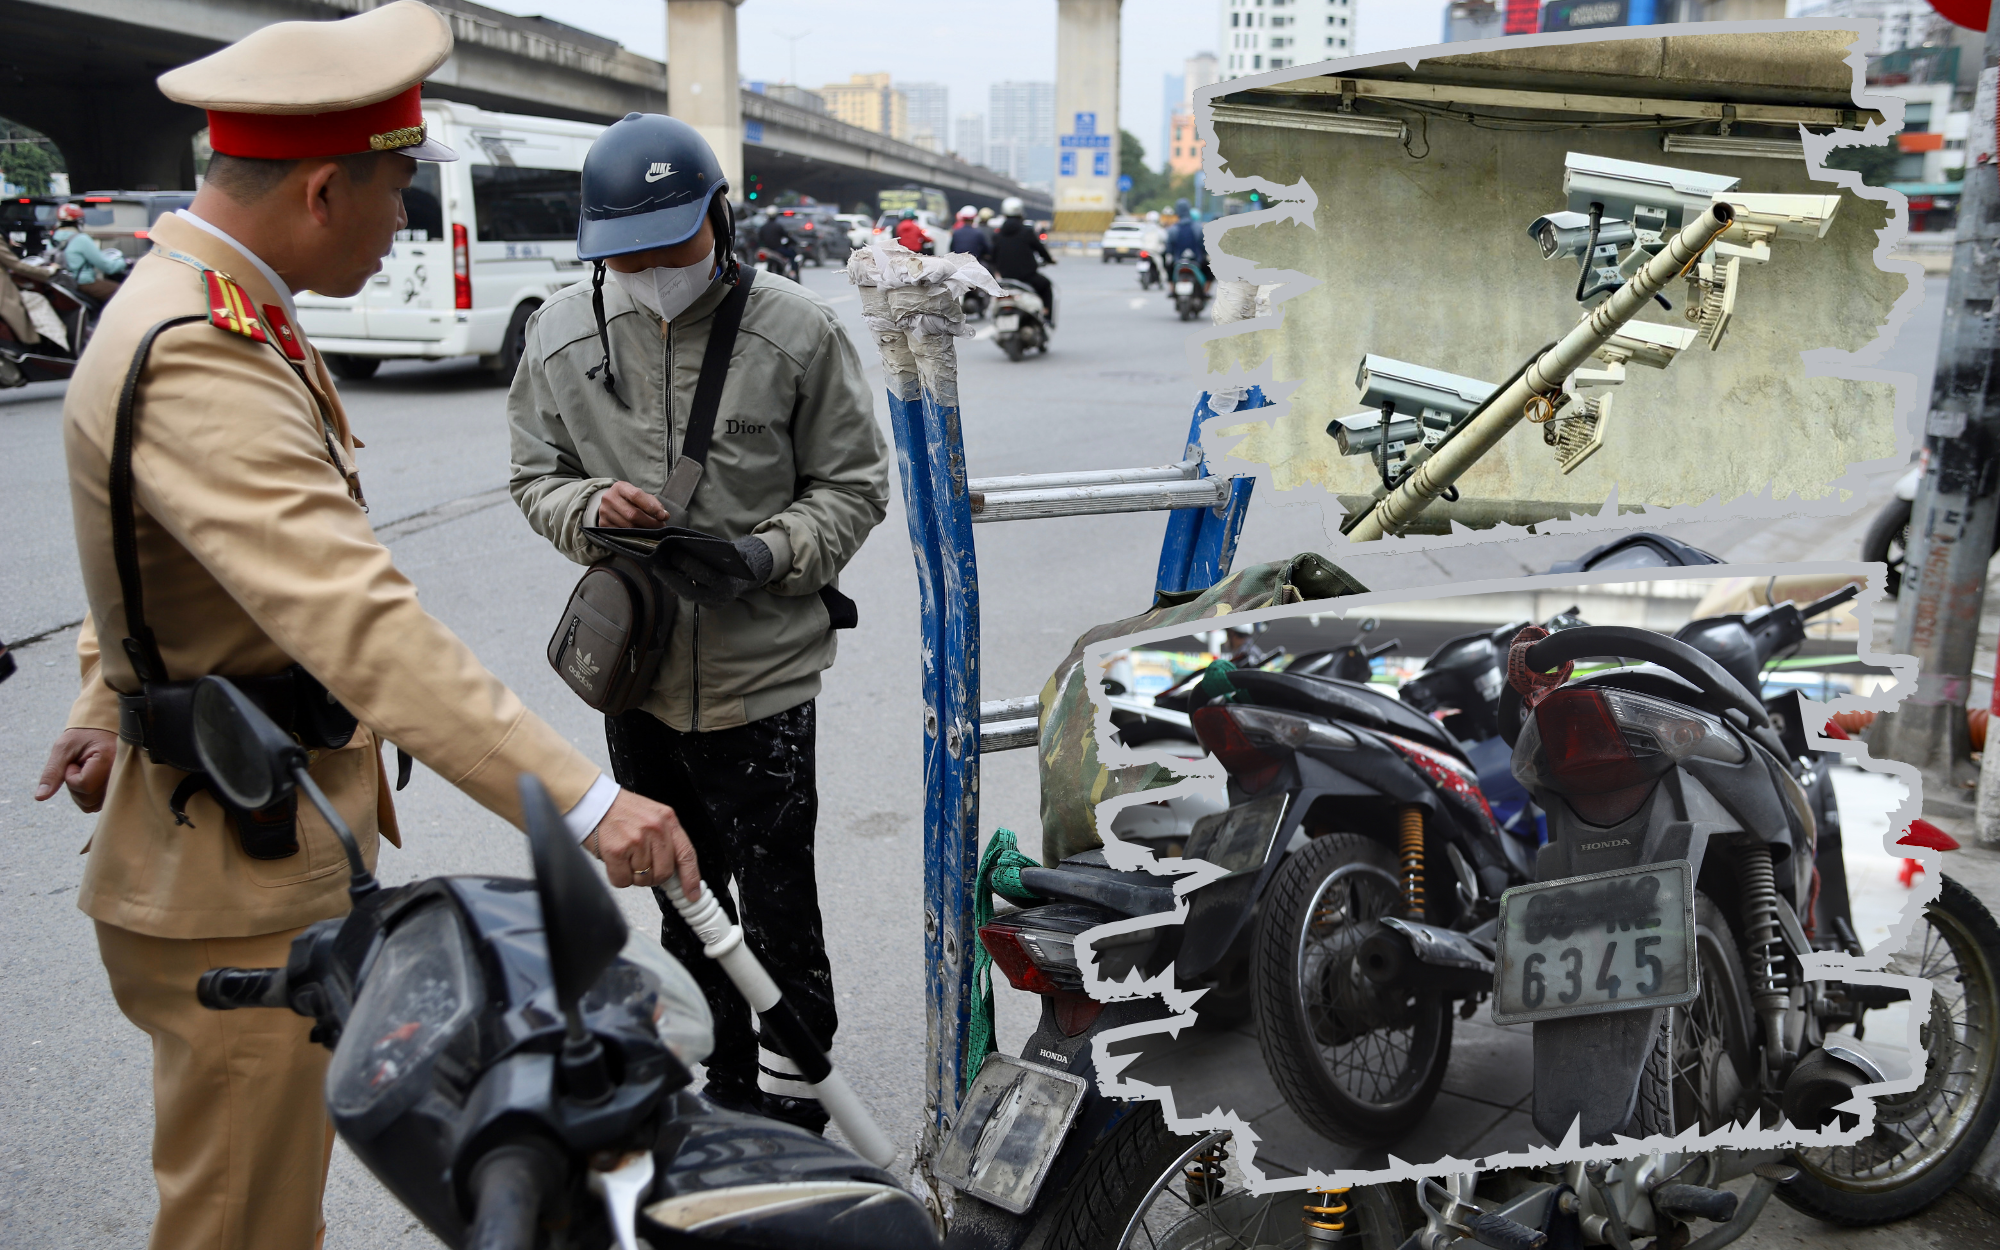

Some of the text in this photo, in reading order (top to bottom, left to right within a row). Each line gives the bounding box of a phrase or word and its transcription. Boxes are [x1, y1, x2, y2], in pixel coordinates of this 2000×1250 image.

[650, 162, 672, 174] NIKE
[725, 419, 766, 434] Dior
[568, 665, 594, 691] adidas
[1580, 838, 1631, 852] HONDA
[1521, 935, 1663, 1009] 6345
[1039, 1048, 1068, 1064] HONDA
